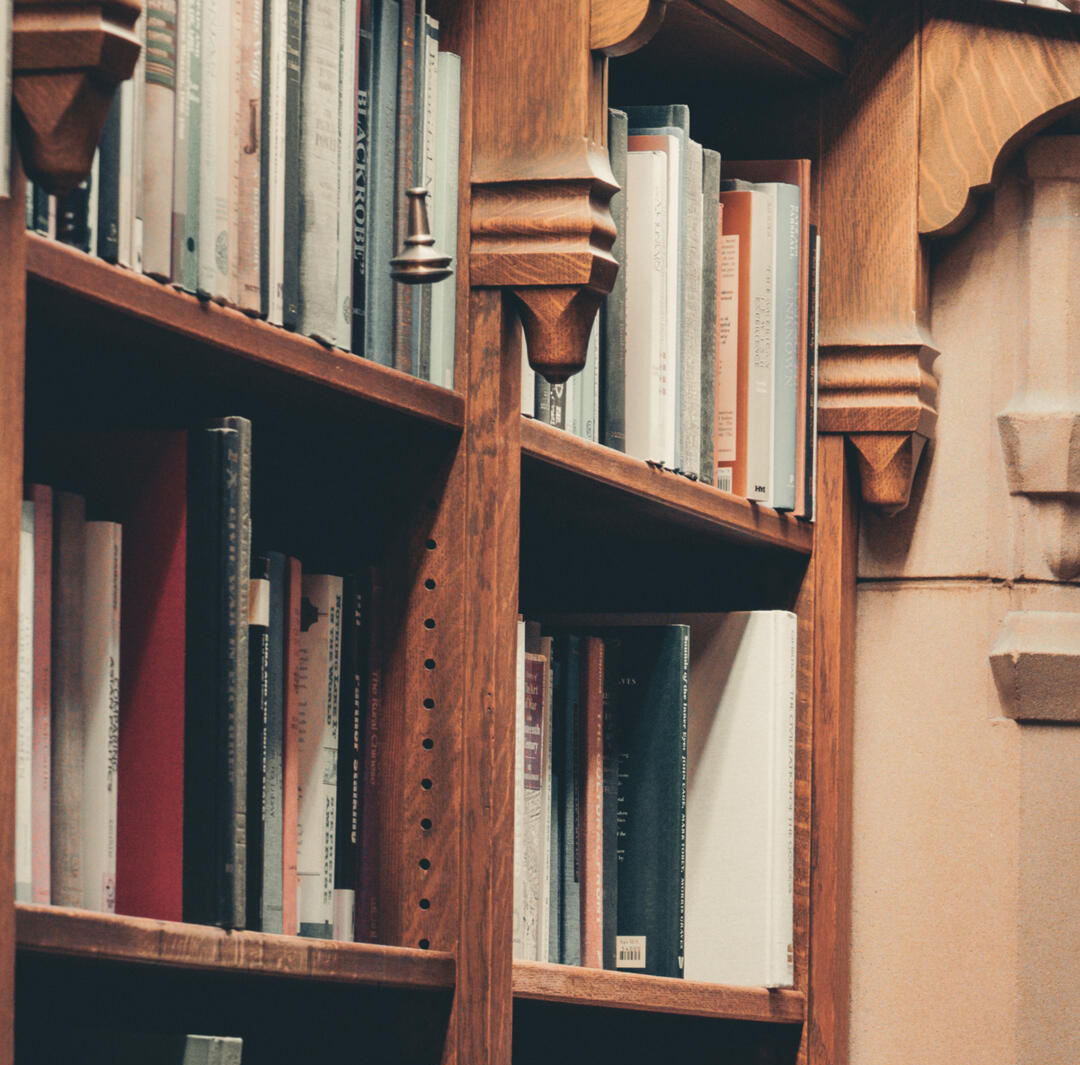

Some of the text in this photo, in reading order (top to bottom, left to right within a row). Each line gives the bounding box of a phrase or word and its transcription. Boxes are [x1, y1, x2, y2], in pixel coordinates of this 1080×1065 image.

[783, 287, 795, 387] UNKNOWN
[327, 628, 335, 662] THE
[325, 665, 334, 726] WORLD
